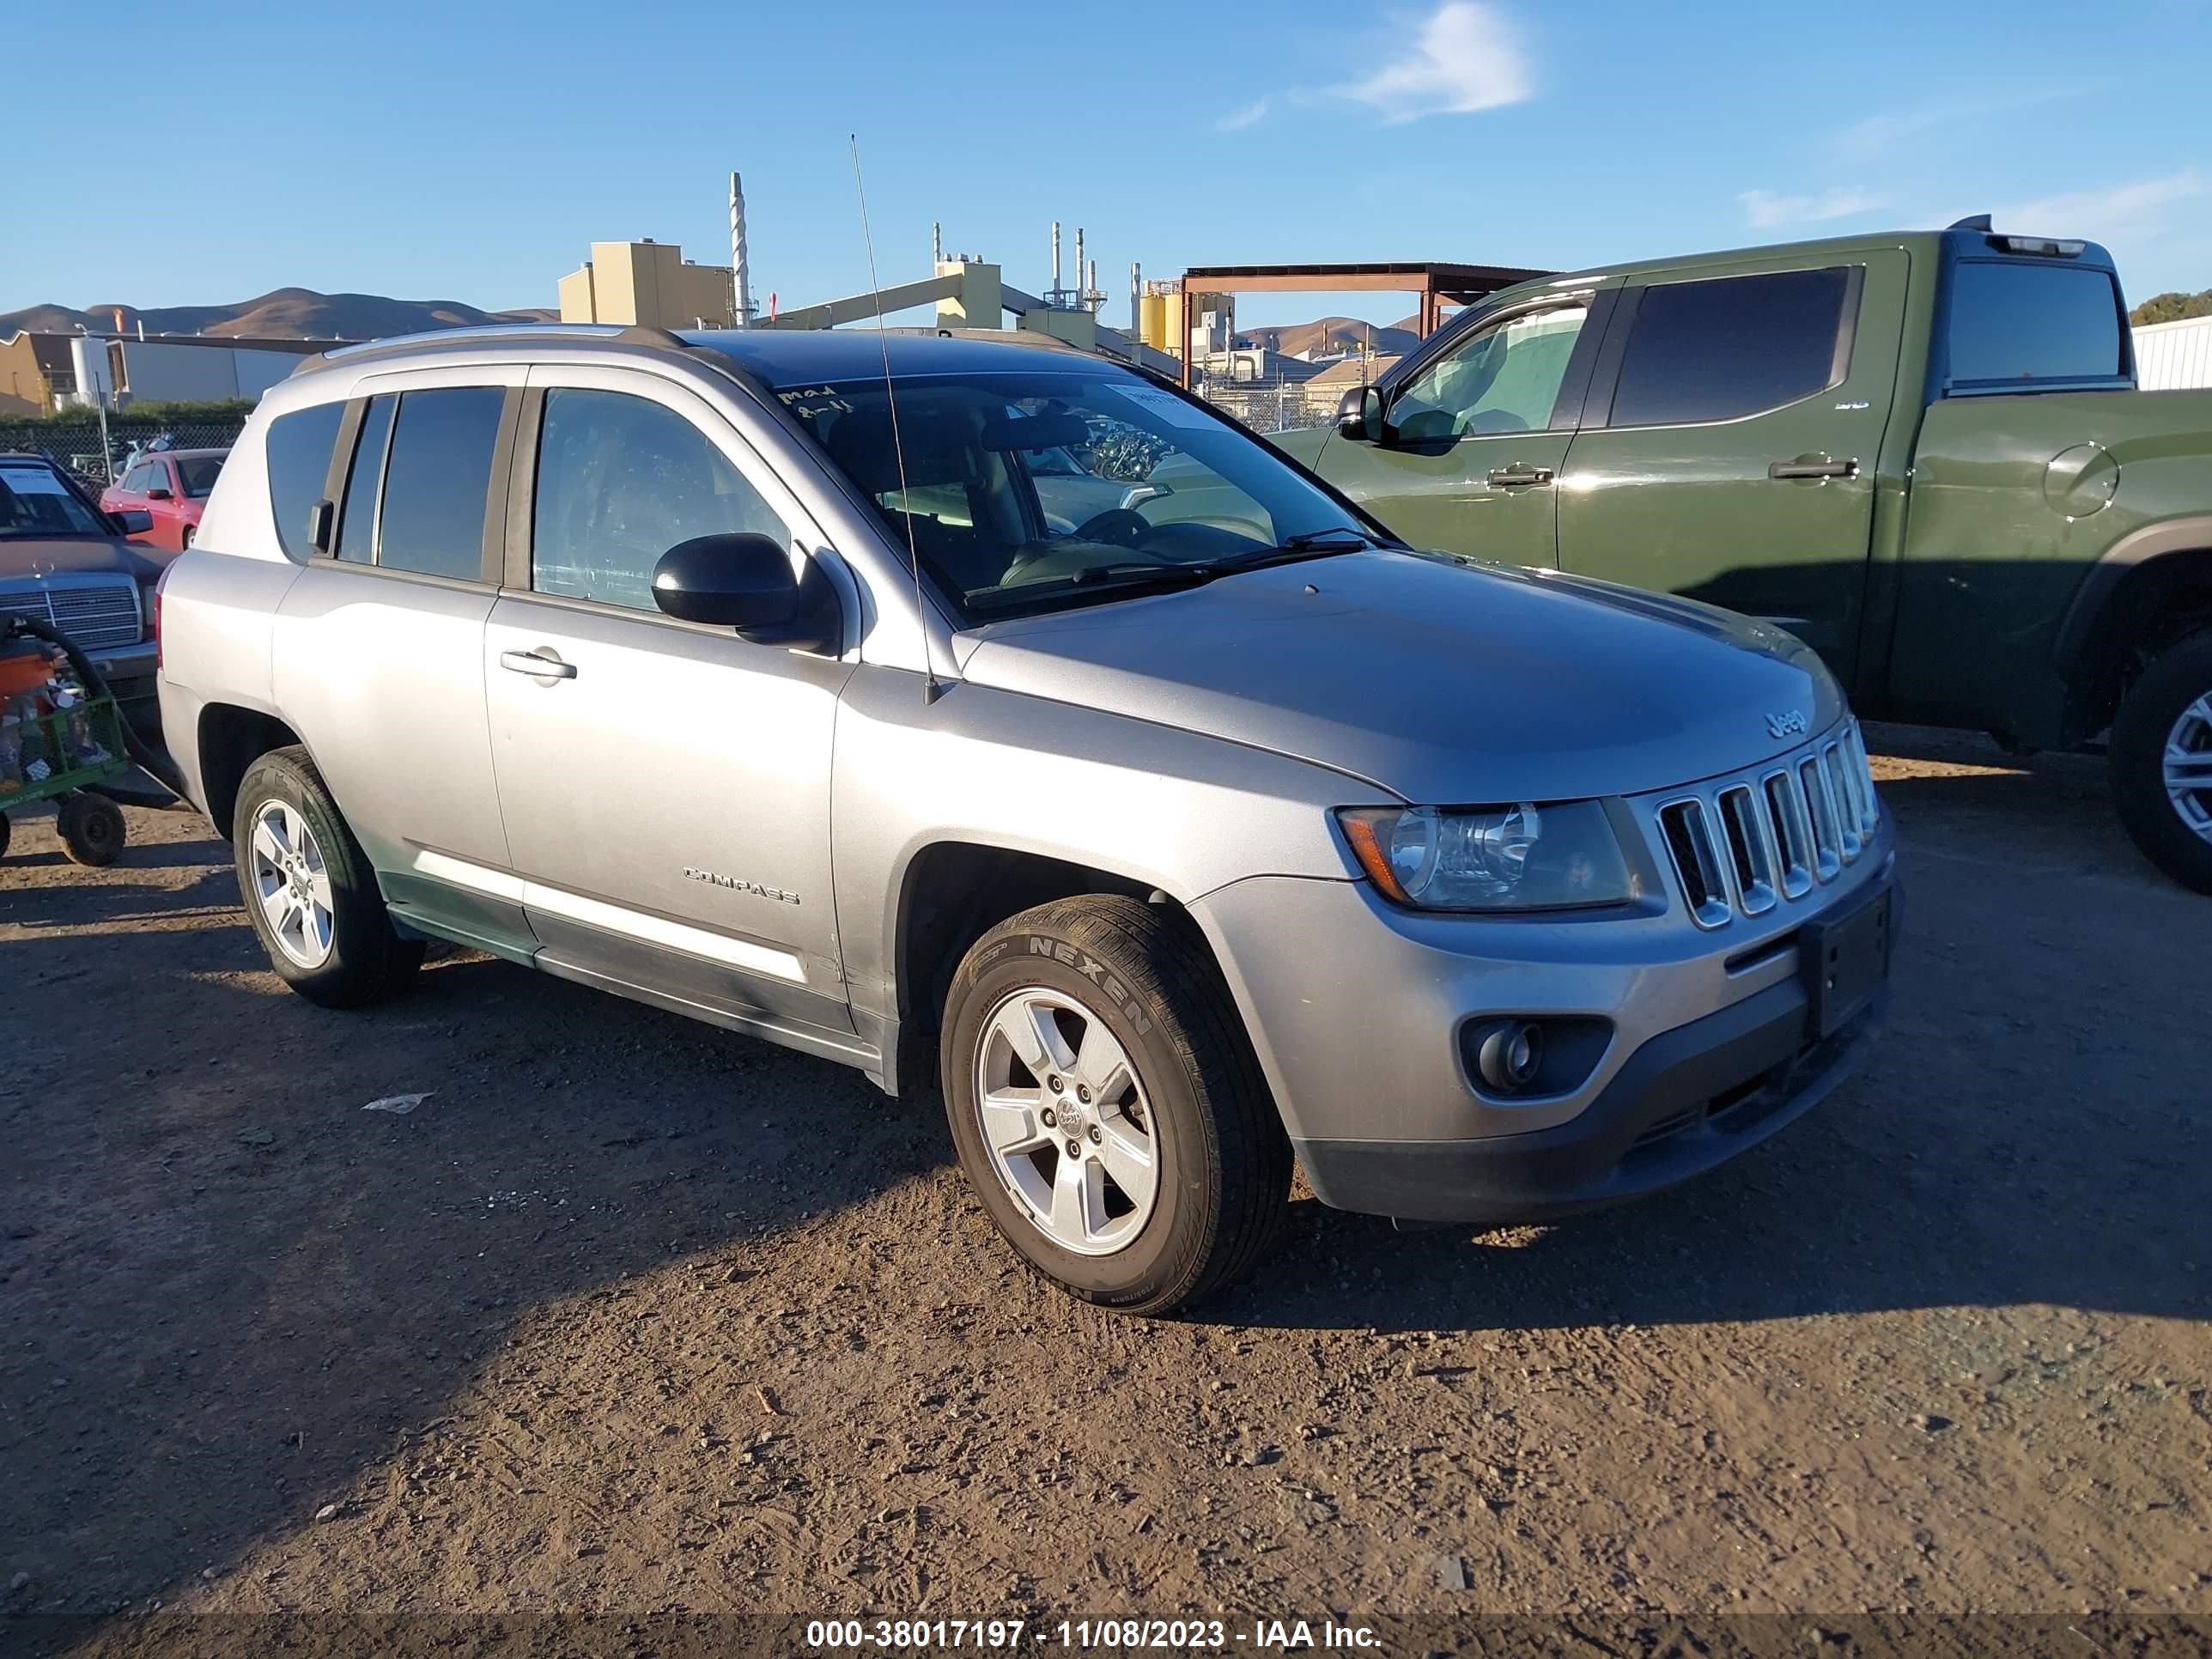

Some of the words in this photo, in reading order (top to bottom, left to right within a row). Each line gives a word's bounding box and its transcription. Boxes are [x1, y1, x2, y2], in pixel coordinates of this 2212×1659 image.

[1765, 710, 1806, 738] Jeep
[683, 861, 801, 906] COMPASS
[1030, 936, 1153, 1036] NEXEN
